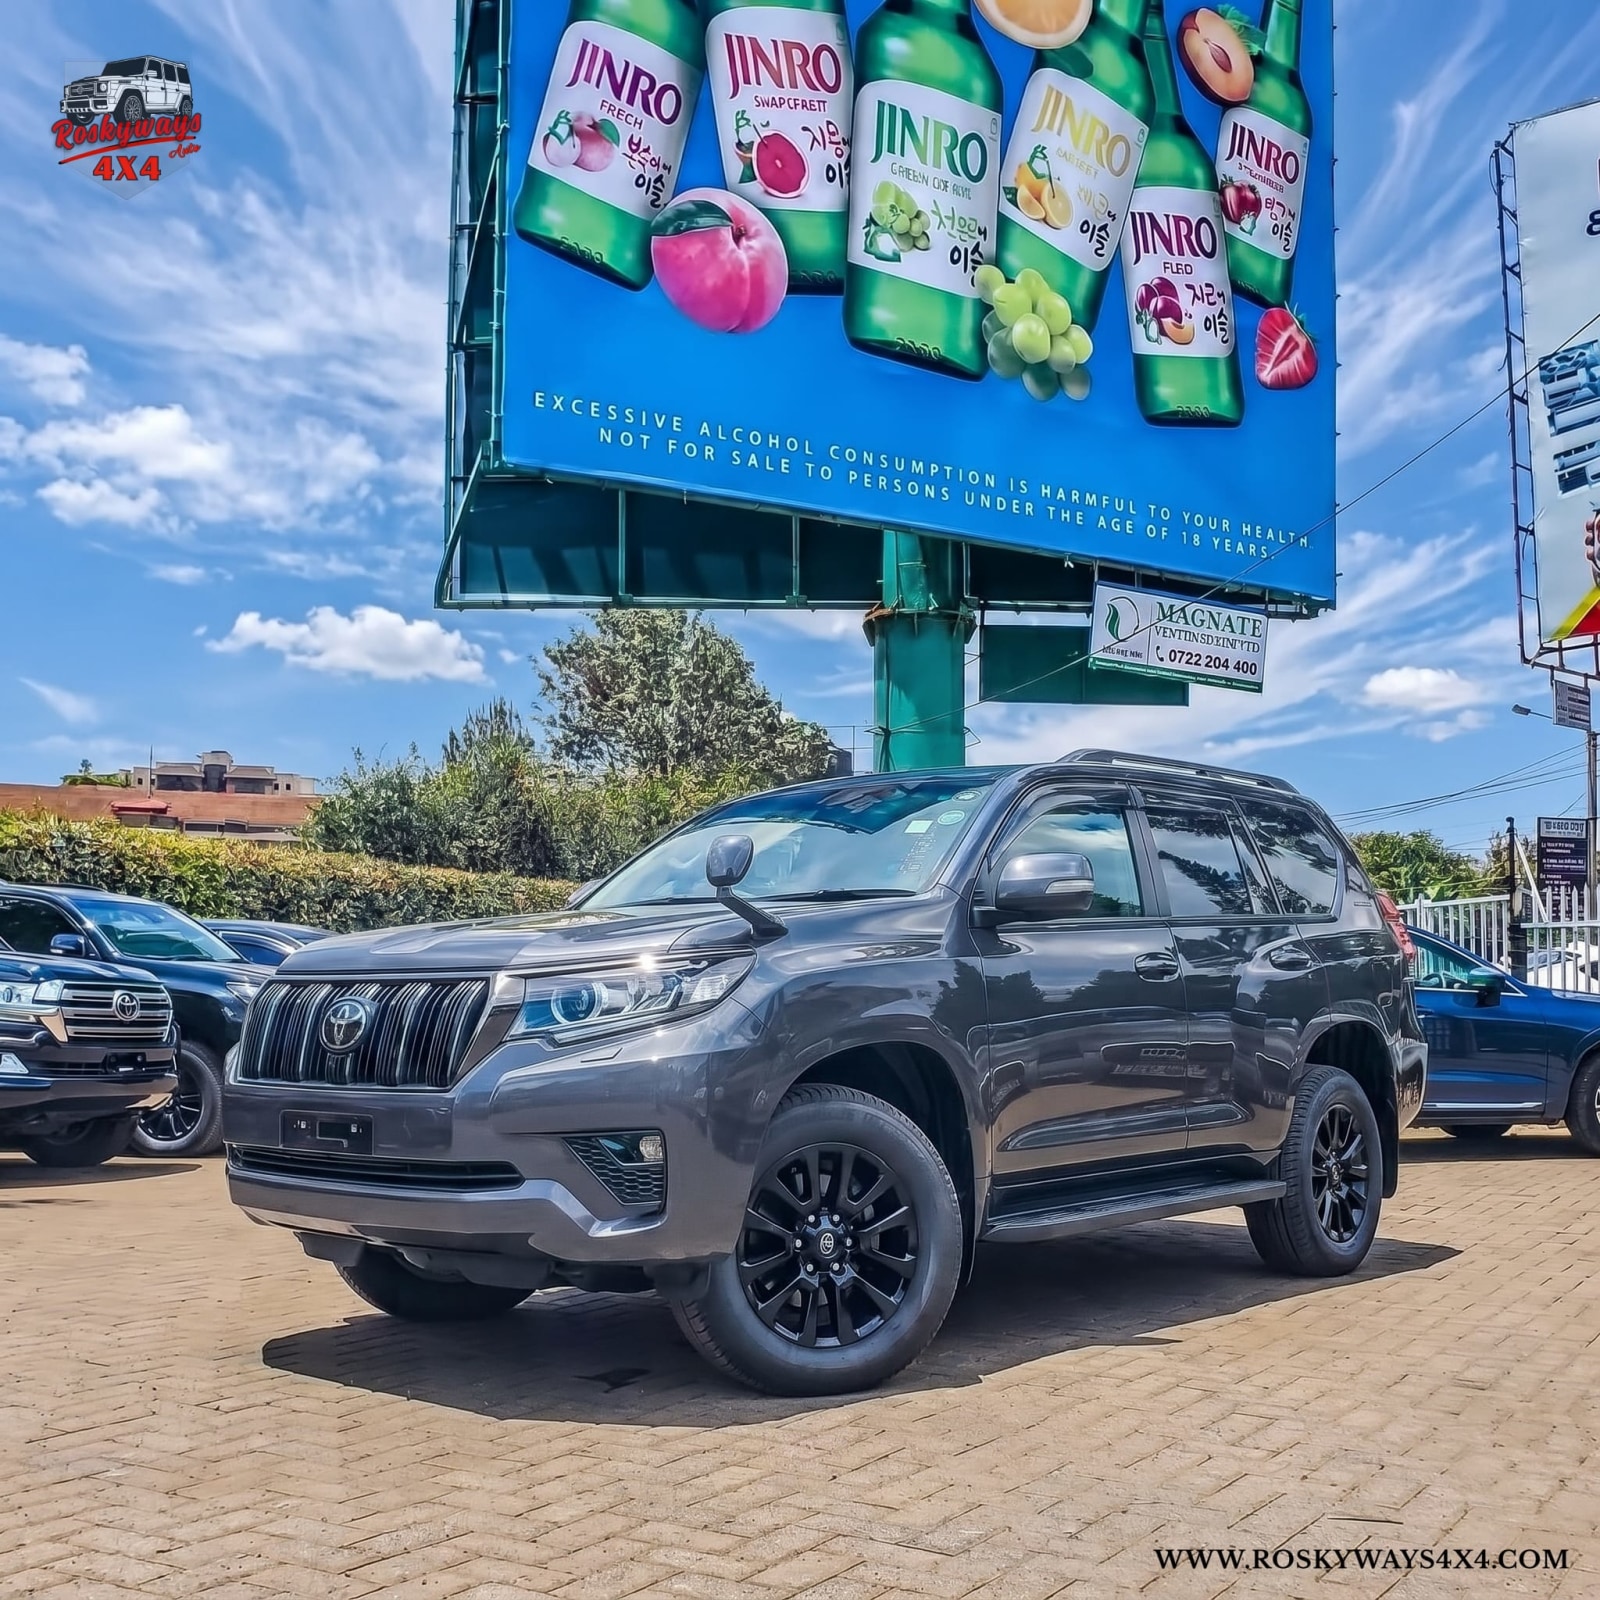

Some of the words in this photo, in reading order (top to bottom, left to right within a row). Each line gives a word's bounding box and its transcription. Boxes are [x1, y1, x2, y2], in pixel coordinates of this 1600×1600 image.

[565, 39, 682, 125] JINRO
[724, 33, 842, 99] JINRO
[870, 100, 988, 183] JINRO
[1031, 84, 1131, 177] JINRO
[1224, 121, 1299, 184] JINRO
[1129, 211, 1218, 266] JINRO
[534, 391, 683, 432] EXCESSIVE
[699, 421, 813, 455] ALCOHOL
[829, 445, 995, 488] CONSUMPTION
[1010, 477, 1028, 494] IS
[1041, 484, 1137, 515] HARMFUL
[1147, 504, 1170, 520] TO
[1181, 511, 1231, 533] YOUR
[600, 427, 651, 450] NOT
[668, 439, 715, 461] FOR
[732, 450, 790, 473] SALE
[805, 462, 832, 480] TO
[849, 470, 949, 501] PERSONS
[965, 491, 1034, 516] UNDER
[1047, 506, 1084, 525] THE
[1097, 515, 1134, 535] AGE
[1146, 524, 1169, 541] OF
[1182, 531, 1200, 546] 18
[1156, 601, 1262, 638] MAGNATE
[1168, 649, 1202, 667] 0722
[1204, 654, 1230, 671] 204
[1233, 660, 1258, 676] 400
